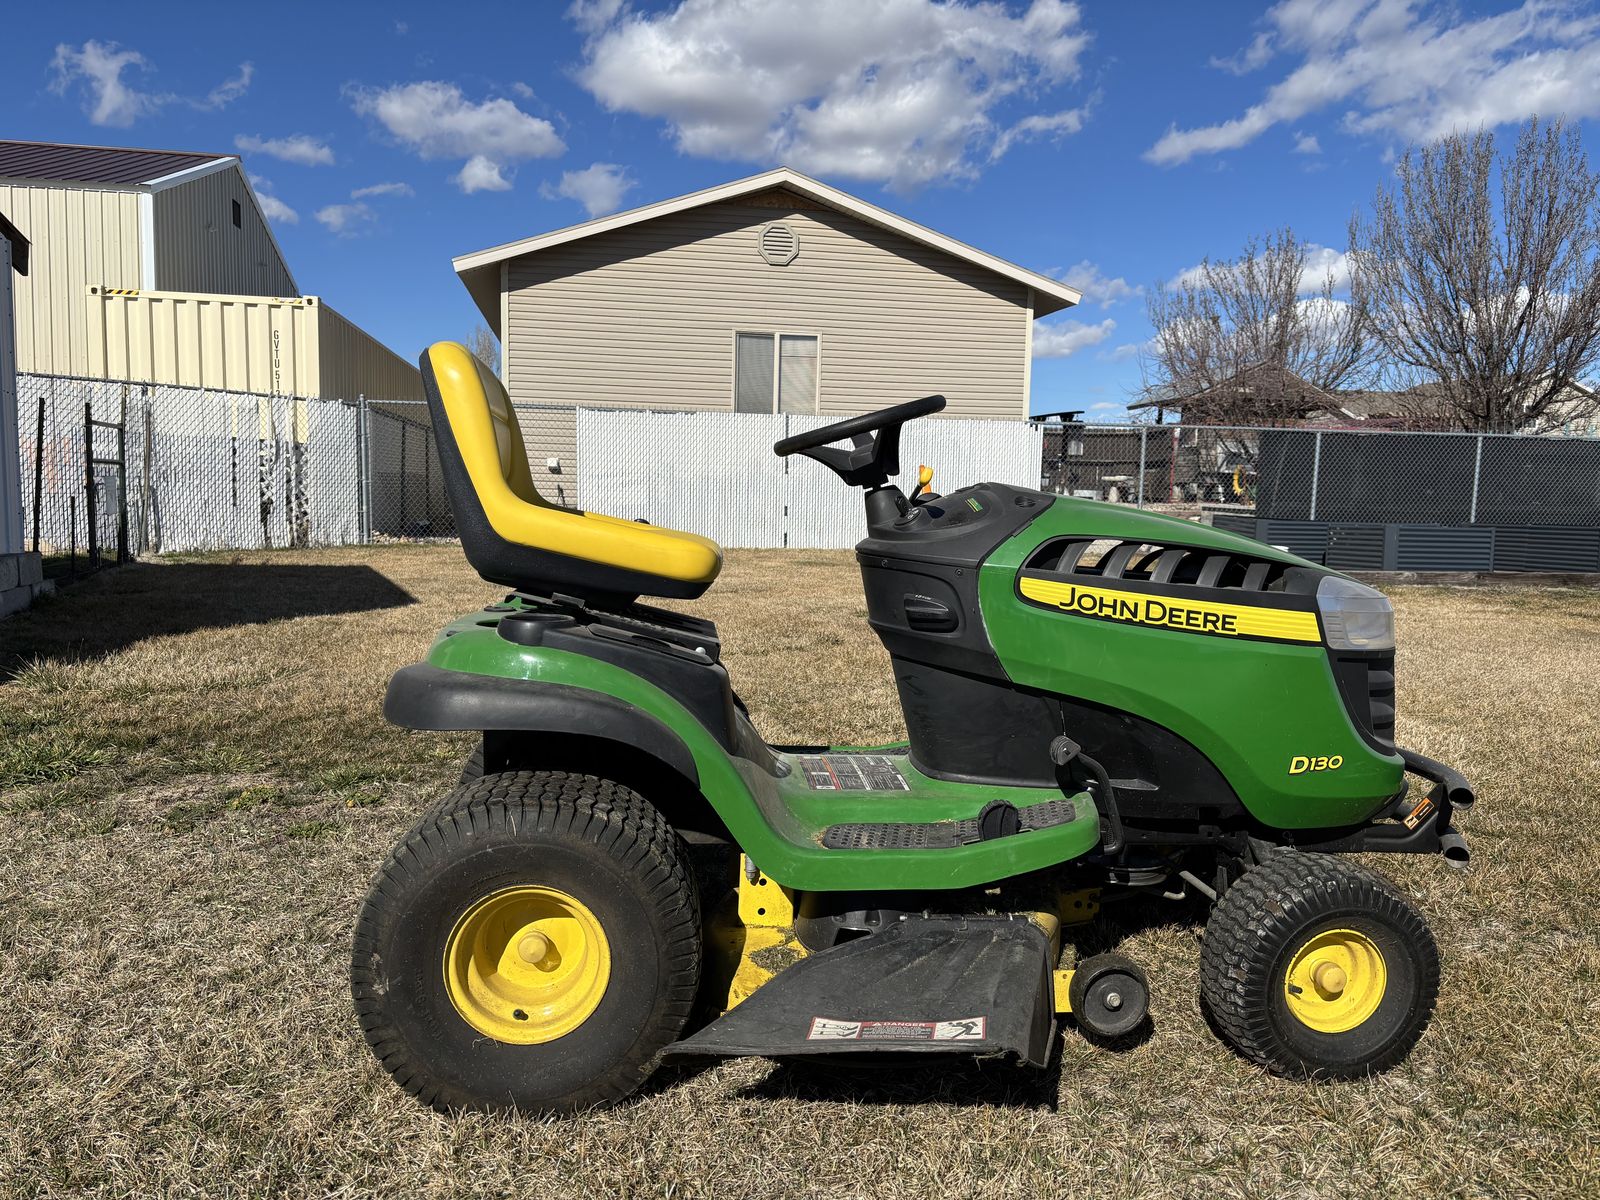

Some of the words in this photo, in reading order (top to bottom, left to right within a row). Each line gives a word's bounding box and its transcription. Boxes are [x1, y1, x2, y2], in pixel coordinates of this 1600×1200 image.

[1059, 587, 1139, 619] JOHN
[1144, 600, 1238, 632] DEERE
[1288, 755, 1343, 774] D130
